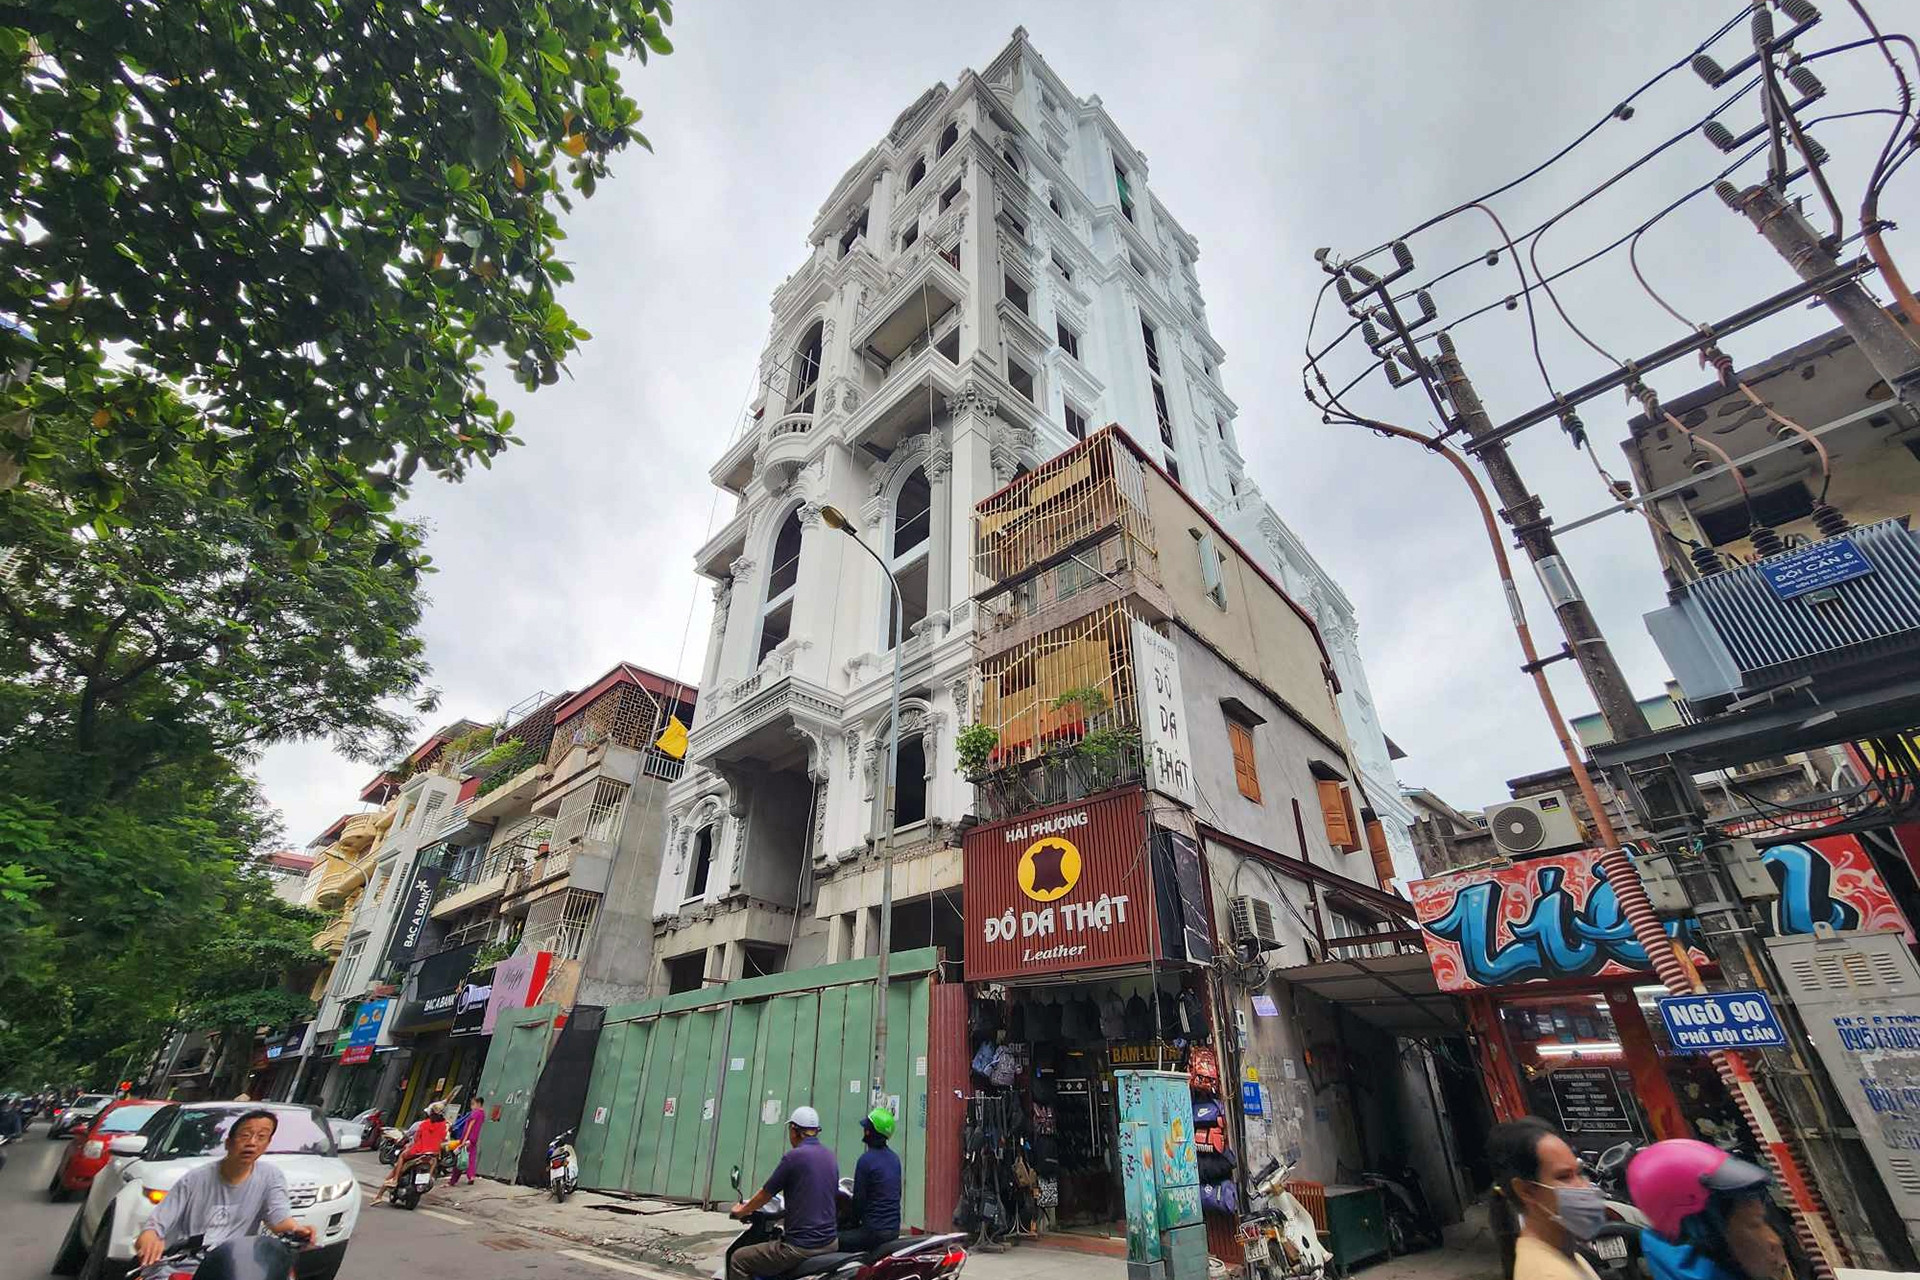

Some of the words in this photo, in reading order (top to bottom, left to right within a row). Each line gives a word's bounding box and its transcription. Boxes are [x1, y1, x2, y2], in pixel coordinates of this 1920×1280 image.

[1775, 568, 1803, 582] ĐỘI
[1159, 704, 1178, 740] DA
[1006, 820, 1028, 843] HẢI
[1030, 811, 1089, 834] PHƯỢNG
[414, 888, 432, 916] BANK
[412, 917, 422, 926] A
[984, 906, 1017, 943] ĐỒ
[1021, 907, 1055, 938] DA
[1061, 893, 1129, 932] THẬT
[403, 926, 418, 948] BAC
[1022, 943, 1087, 962] Leather
[1668, 998, 1726, 1027] NGÕ
[1729, 1000, 1766, 1023] 90
[1678, 1027, 1711, 1045] PHỐ
[1712, 1027, 1740, 1045] ĐỘI
[1741, 1024, 1777, 1042] CẤN
